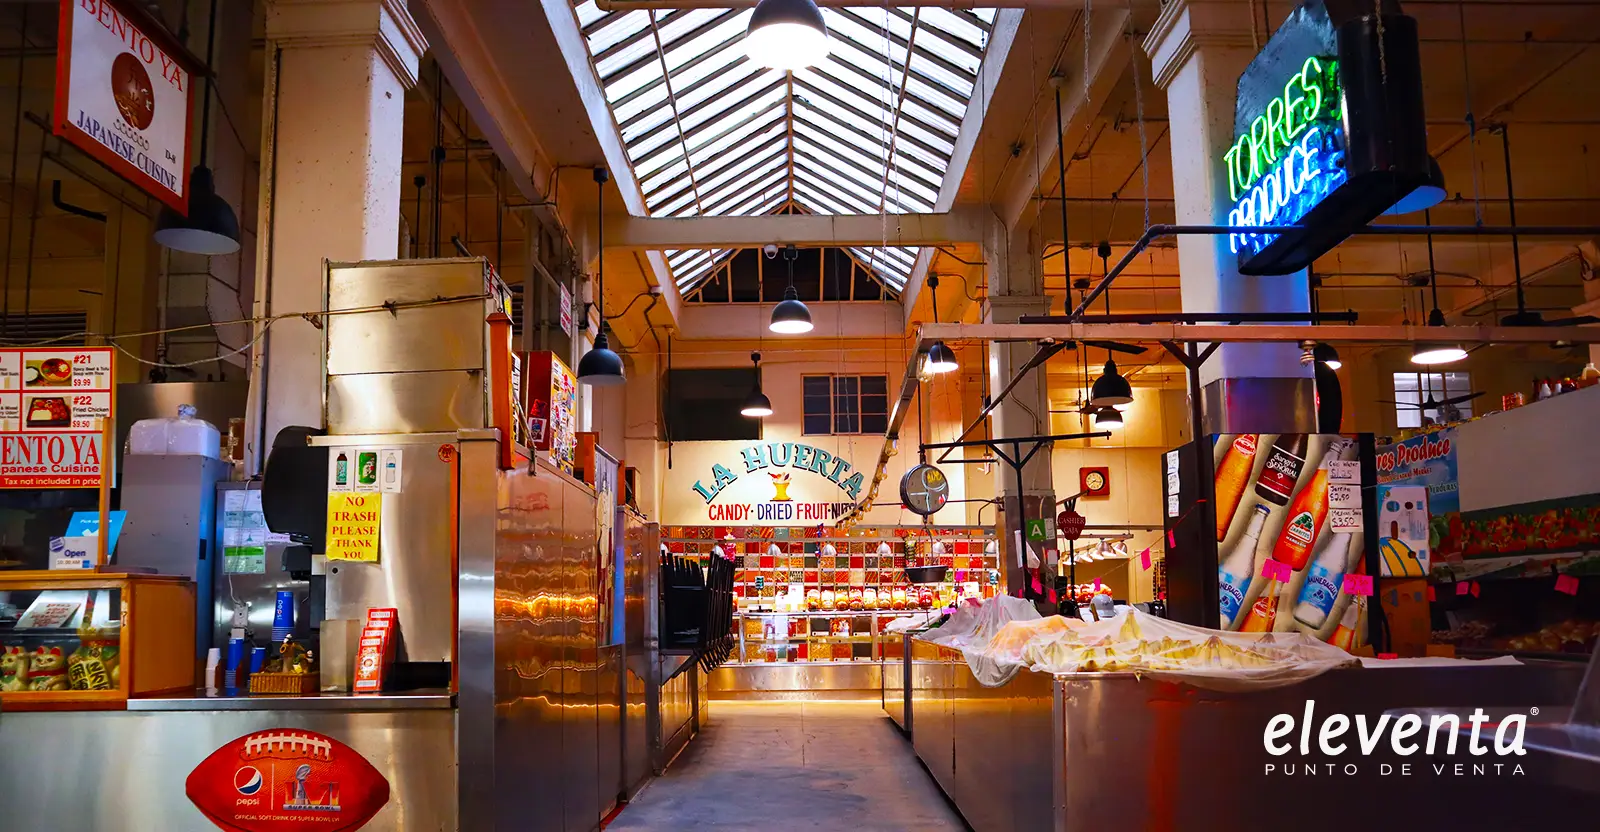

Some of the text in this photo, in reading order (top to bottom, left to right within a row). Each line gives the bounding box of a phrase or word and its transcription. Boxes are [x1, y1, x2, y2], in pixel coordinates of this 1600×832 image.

[159, 50, 184, 92] YA
[1224, 56, 1322, 201] TORRES
[77, 110, 177, 192] JAPANESE CUISINE
[1228, 127, 1321, 253] PRODUCE
[73, 355, 91, 364] #21
[73, 379, 91, 387] $9.99
[73, 396, 92, 405] #22
[70, 436, 100, 465] YA
[1397, 436, 1450, 467] Produce
[51, 465, 98, 473] Cuisine
[692, 443, 865, 504] LA HUERTA
[346, 496, 365, 506] NO
[332, 512, 376, 521] TRASH
[709, 504, 751, 520] CANDY
[757, 503, 793, 520] DRIED
[332, 526, 376, 535] PLEASE
[1031, 524, 1043, 537] A
[64, 550, 86, 558] Open
[343, 551, 364, 559] YOU
[236, 798, 260, 806] pepsi
